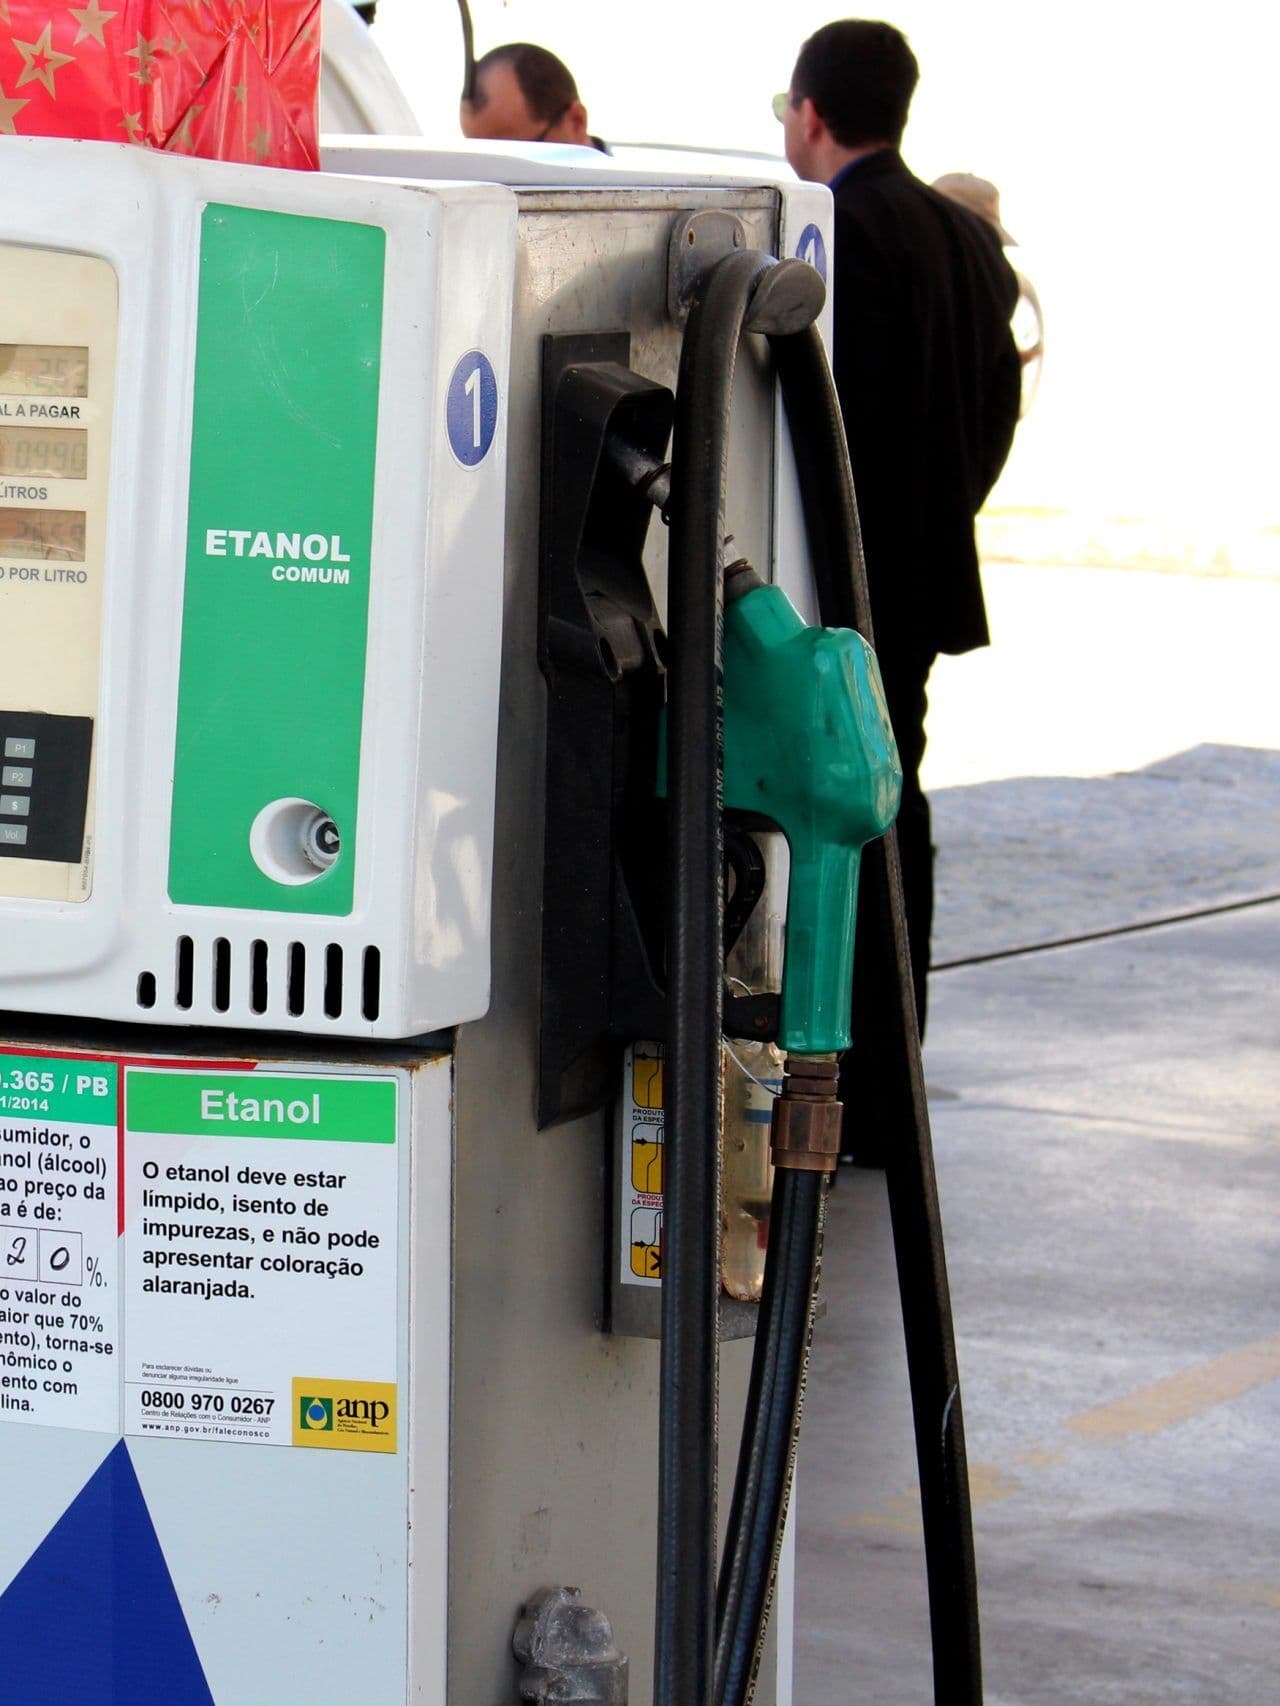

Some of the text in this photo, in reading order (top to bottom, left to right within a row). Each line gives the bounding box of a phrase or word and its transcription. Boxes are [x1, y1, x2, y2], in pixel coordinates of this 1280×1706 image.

[16, 404, 26, 416] A
[30, 405, 80, 419] PAGAR
[465, 368, 481, 448] 1
[205, 529, 351, 562] ETANOL
[9, 567, 39, 581] POR
[45, 570, 87, 583] LITRO
[272, 565, 350, 584] COMUM
[15, 743, 26, 752] P1
[12, 773, 23, 782] P2
[76, 1076, 108, 1097] PB
[201, 1089, 320, 1124] Etanol
[80, 1136, 91, 1149] o
[38, 1152, 106, 1179] (álcool)
[142, 1162, 346, 1189] O etanol deve estar
[25, 1180, 77, 1200] preço
[83, 1182, 105, 1200] da
[17, 1200, 27, 1218] é
[34, 1202, 62, 1221] de:
[143, 1189, 329, 1216] límpido, isento de
[143, 1218, 380, 1250] impurezas, e não pode
[143, 1250, 364, 1279] apresentar coloração
[0, 1288, 9, 1300] o
[15, 1289, 55, 1305] valor
[61, 1292, 81, 1308] do
[143, 1276, 255, 1300] alaranjada.
[35, 1314, 64, 1330] que
[70, 1314, 103, 1332] 70%
[46, 1336, 113, 1354] torna-se
[63, 1360, 72, 1372] o
[43, 1379, 78, 1395] com
[141, 1390, 275, 1415] 0800 970 0267
[337, 1398, 389, 1427] anp
[170, 1411, 197, 1420] Relações
[217, 1414, 252, 1423] Consumidor
[142, 1423, 270, 1437] www.anp.gov.br/faleconosco
